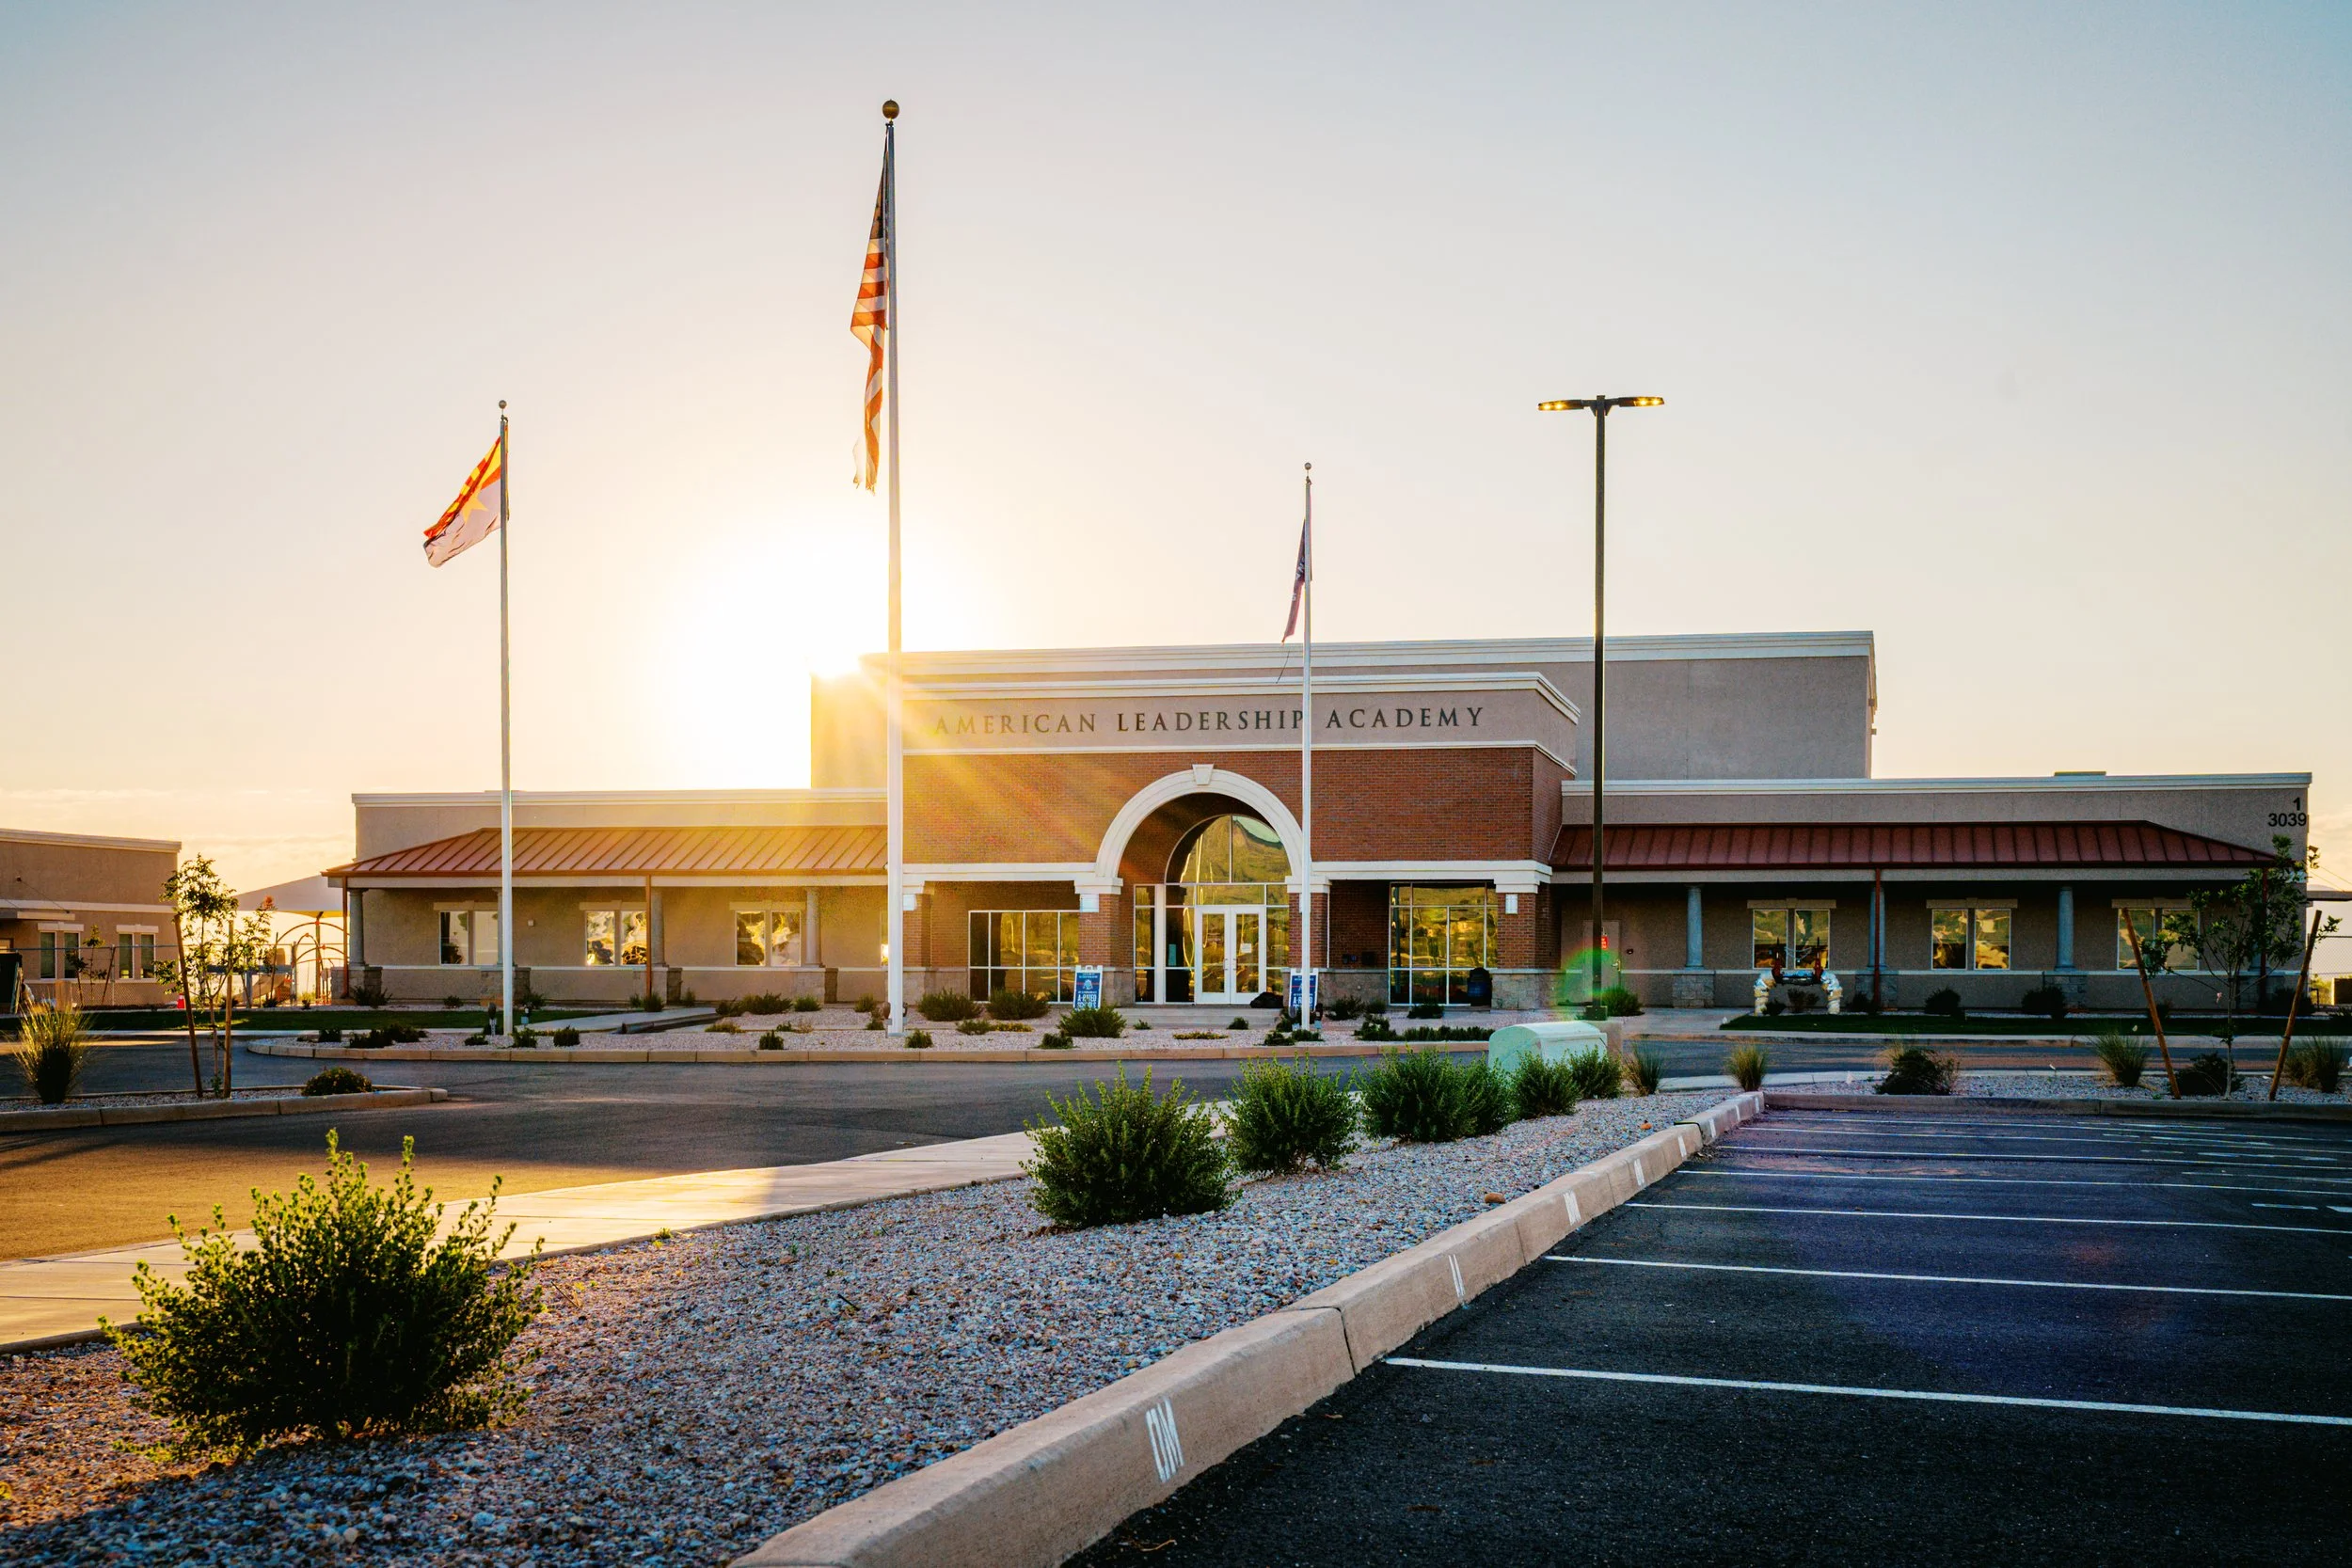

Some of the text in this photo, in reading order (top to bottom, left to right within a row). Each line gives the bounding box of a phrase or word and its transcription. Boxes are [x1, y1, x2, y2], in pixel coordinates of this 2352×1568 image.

[934, 707, 1484, 735] AMERICAN LEADERSHIP ACADEMY
[2293, 797, 2301, 811] 1
[2267, 813, 2307, 827] 3039
